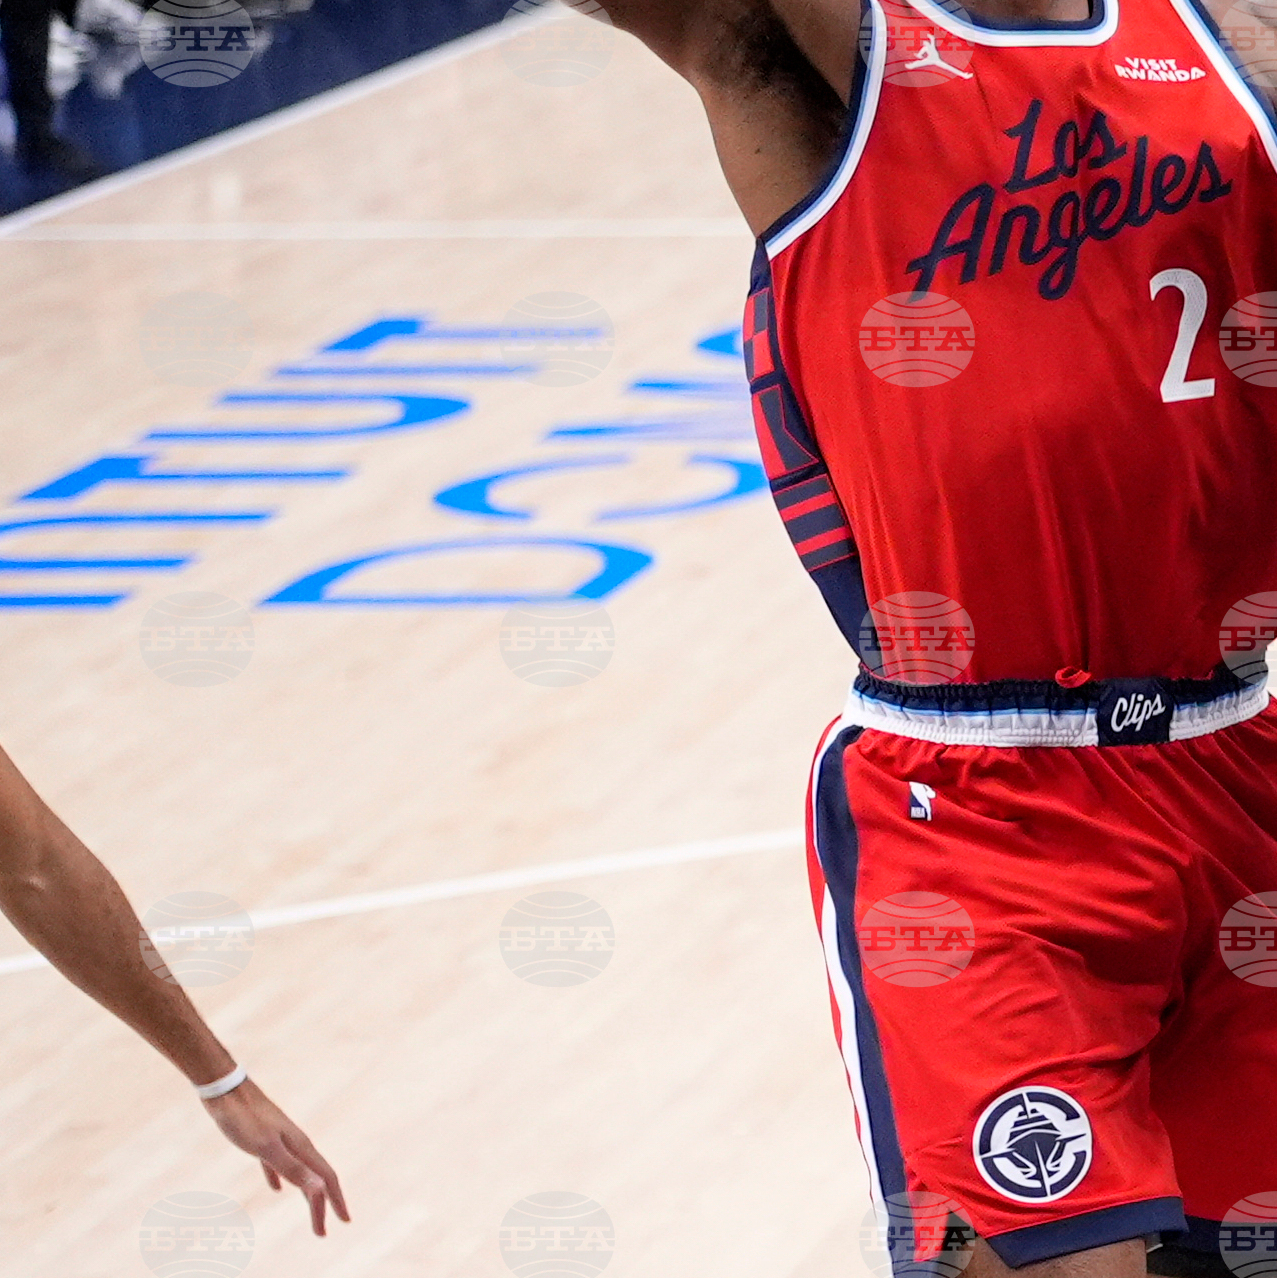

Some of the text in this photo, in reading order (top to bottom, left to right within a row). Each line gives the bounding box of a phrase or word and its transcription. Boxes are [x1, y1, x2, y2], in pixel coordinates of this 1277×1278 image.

[1114, 64, 1207, 82] RWANDA
[1124, 56, 1178, 71] VISIT
[1003, 99, 1128, 195] Los
[904, 135, 1233, 305] Angeles
[1149, 267, 1216, 404] 2
[1110, 692, 1167, 733] Clips
